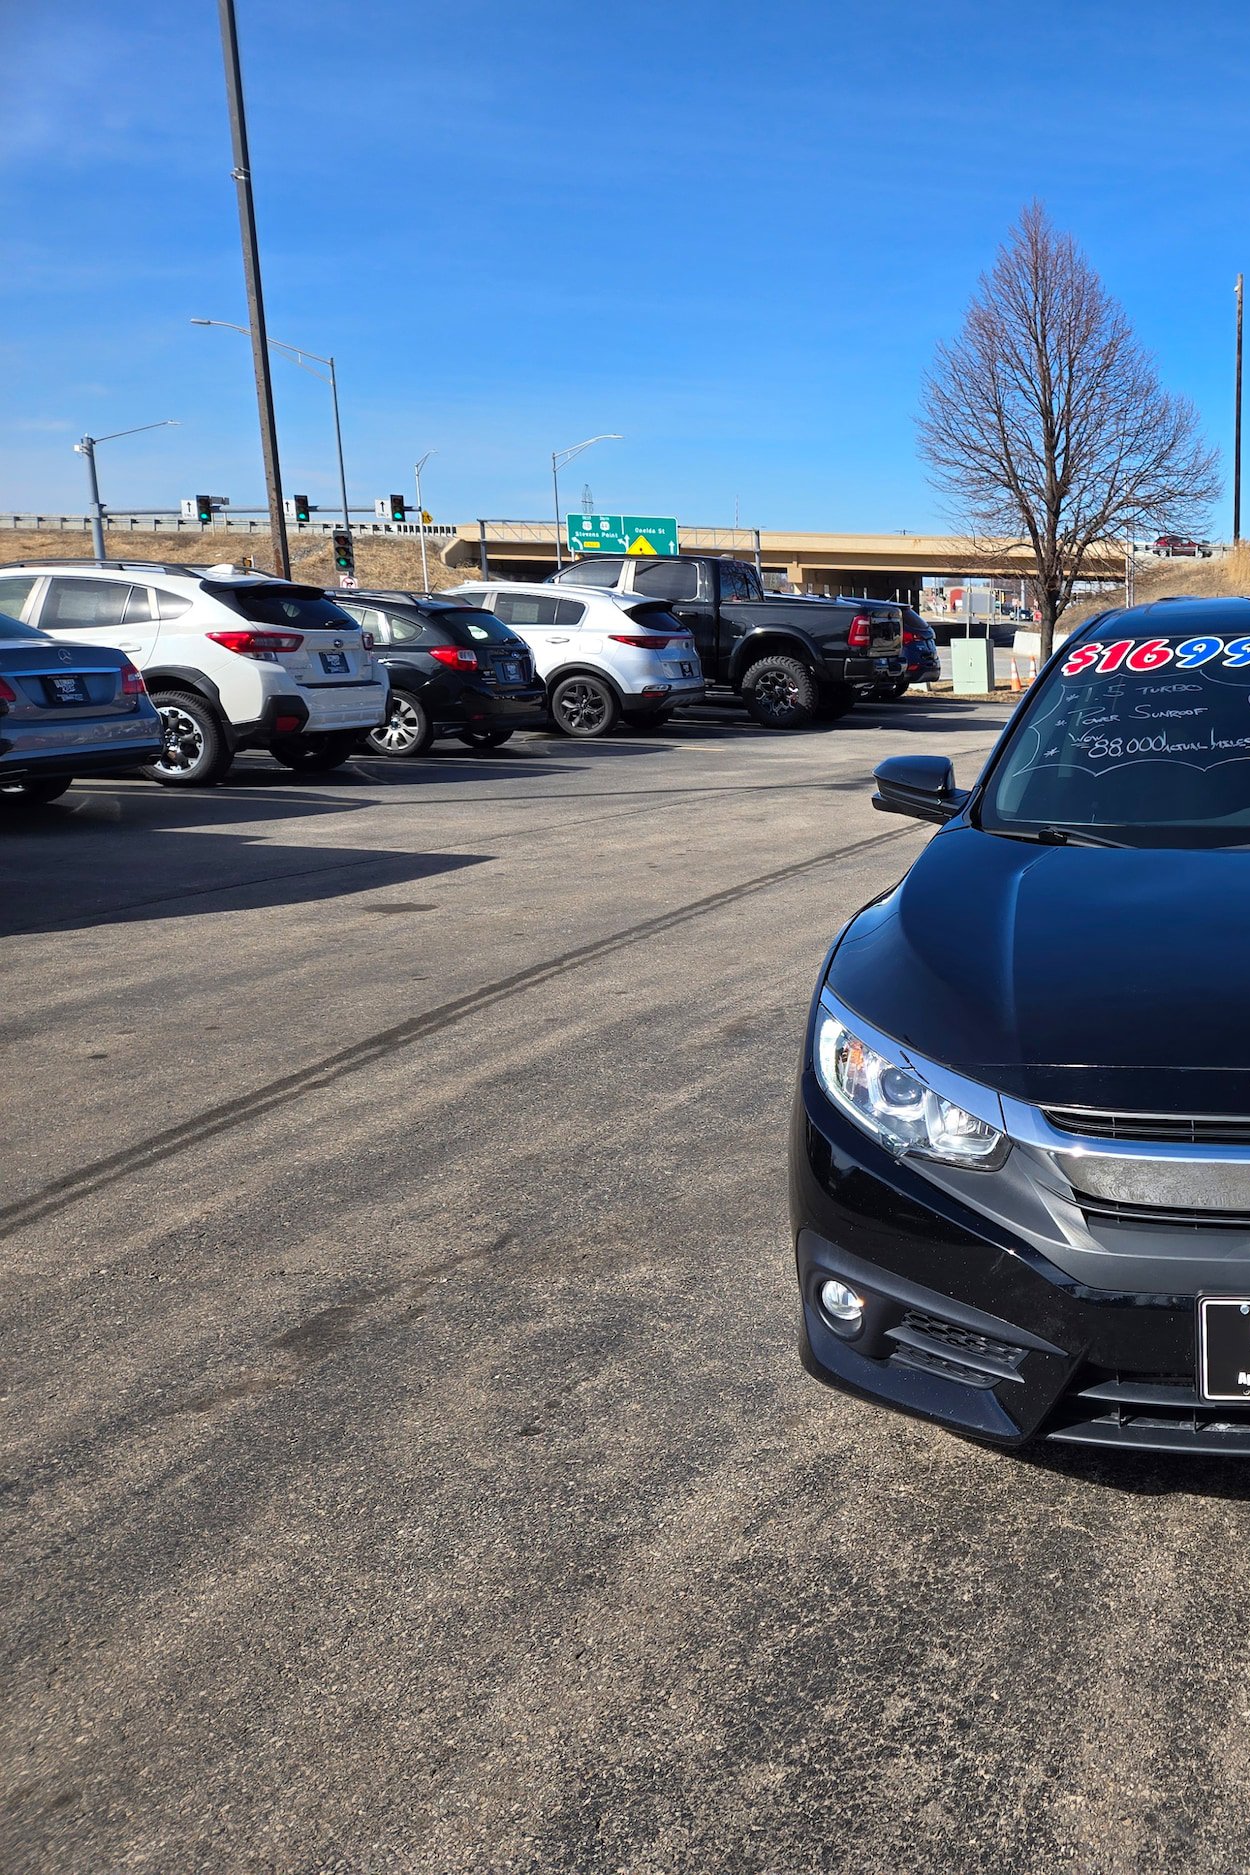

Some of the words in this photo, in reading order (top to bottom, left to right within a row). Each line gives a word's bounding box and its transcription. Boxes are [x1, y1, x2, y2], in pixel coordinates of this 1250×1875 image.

[601, 531, 618, 539] Point
[658, 527, 666, 535] St
[1085, 684, 1125, 702] 1.5
[1135, 684, 1203, 695] TURBO
